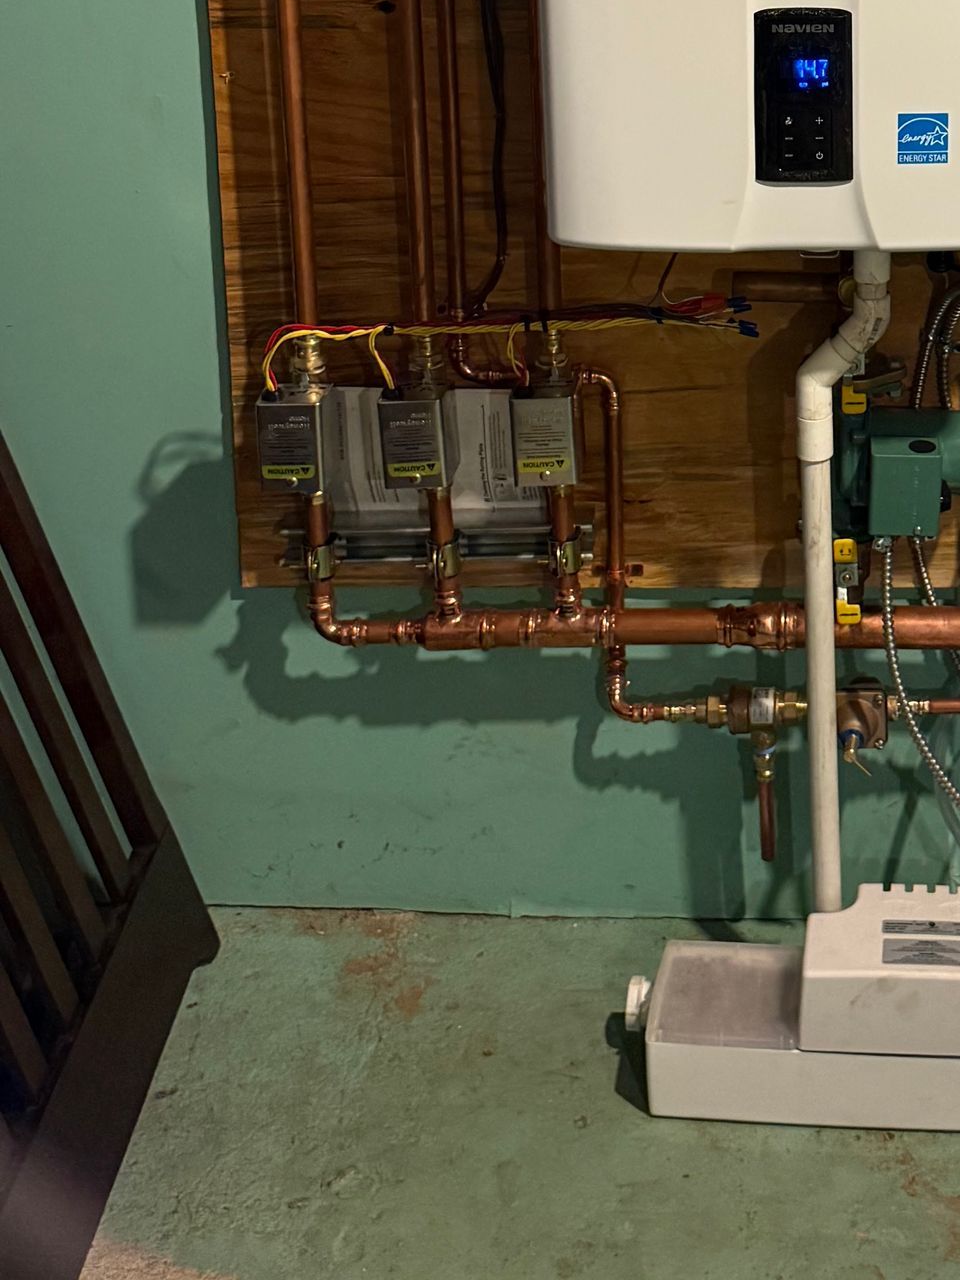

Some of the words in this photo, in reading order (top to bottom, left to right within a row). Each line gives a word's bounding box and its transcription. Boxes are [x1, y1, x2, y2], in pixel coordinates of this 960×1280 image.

[899, 154, 928, 163] ENERGY
[929, 154, 947, 162] STAR
[394, 464, 426, 472] CAUTION
